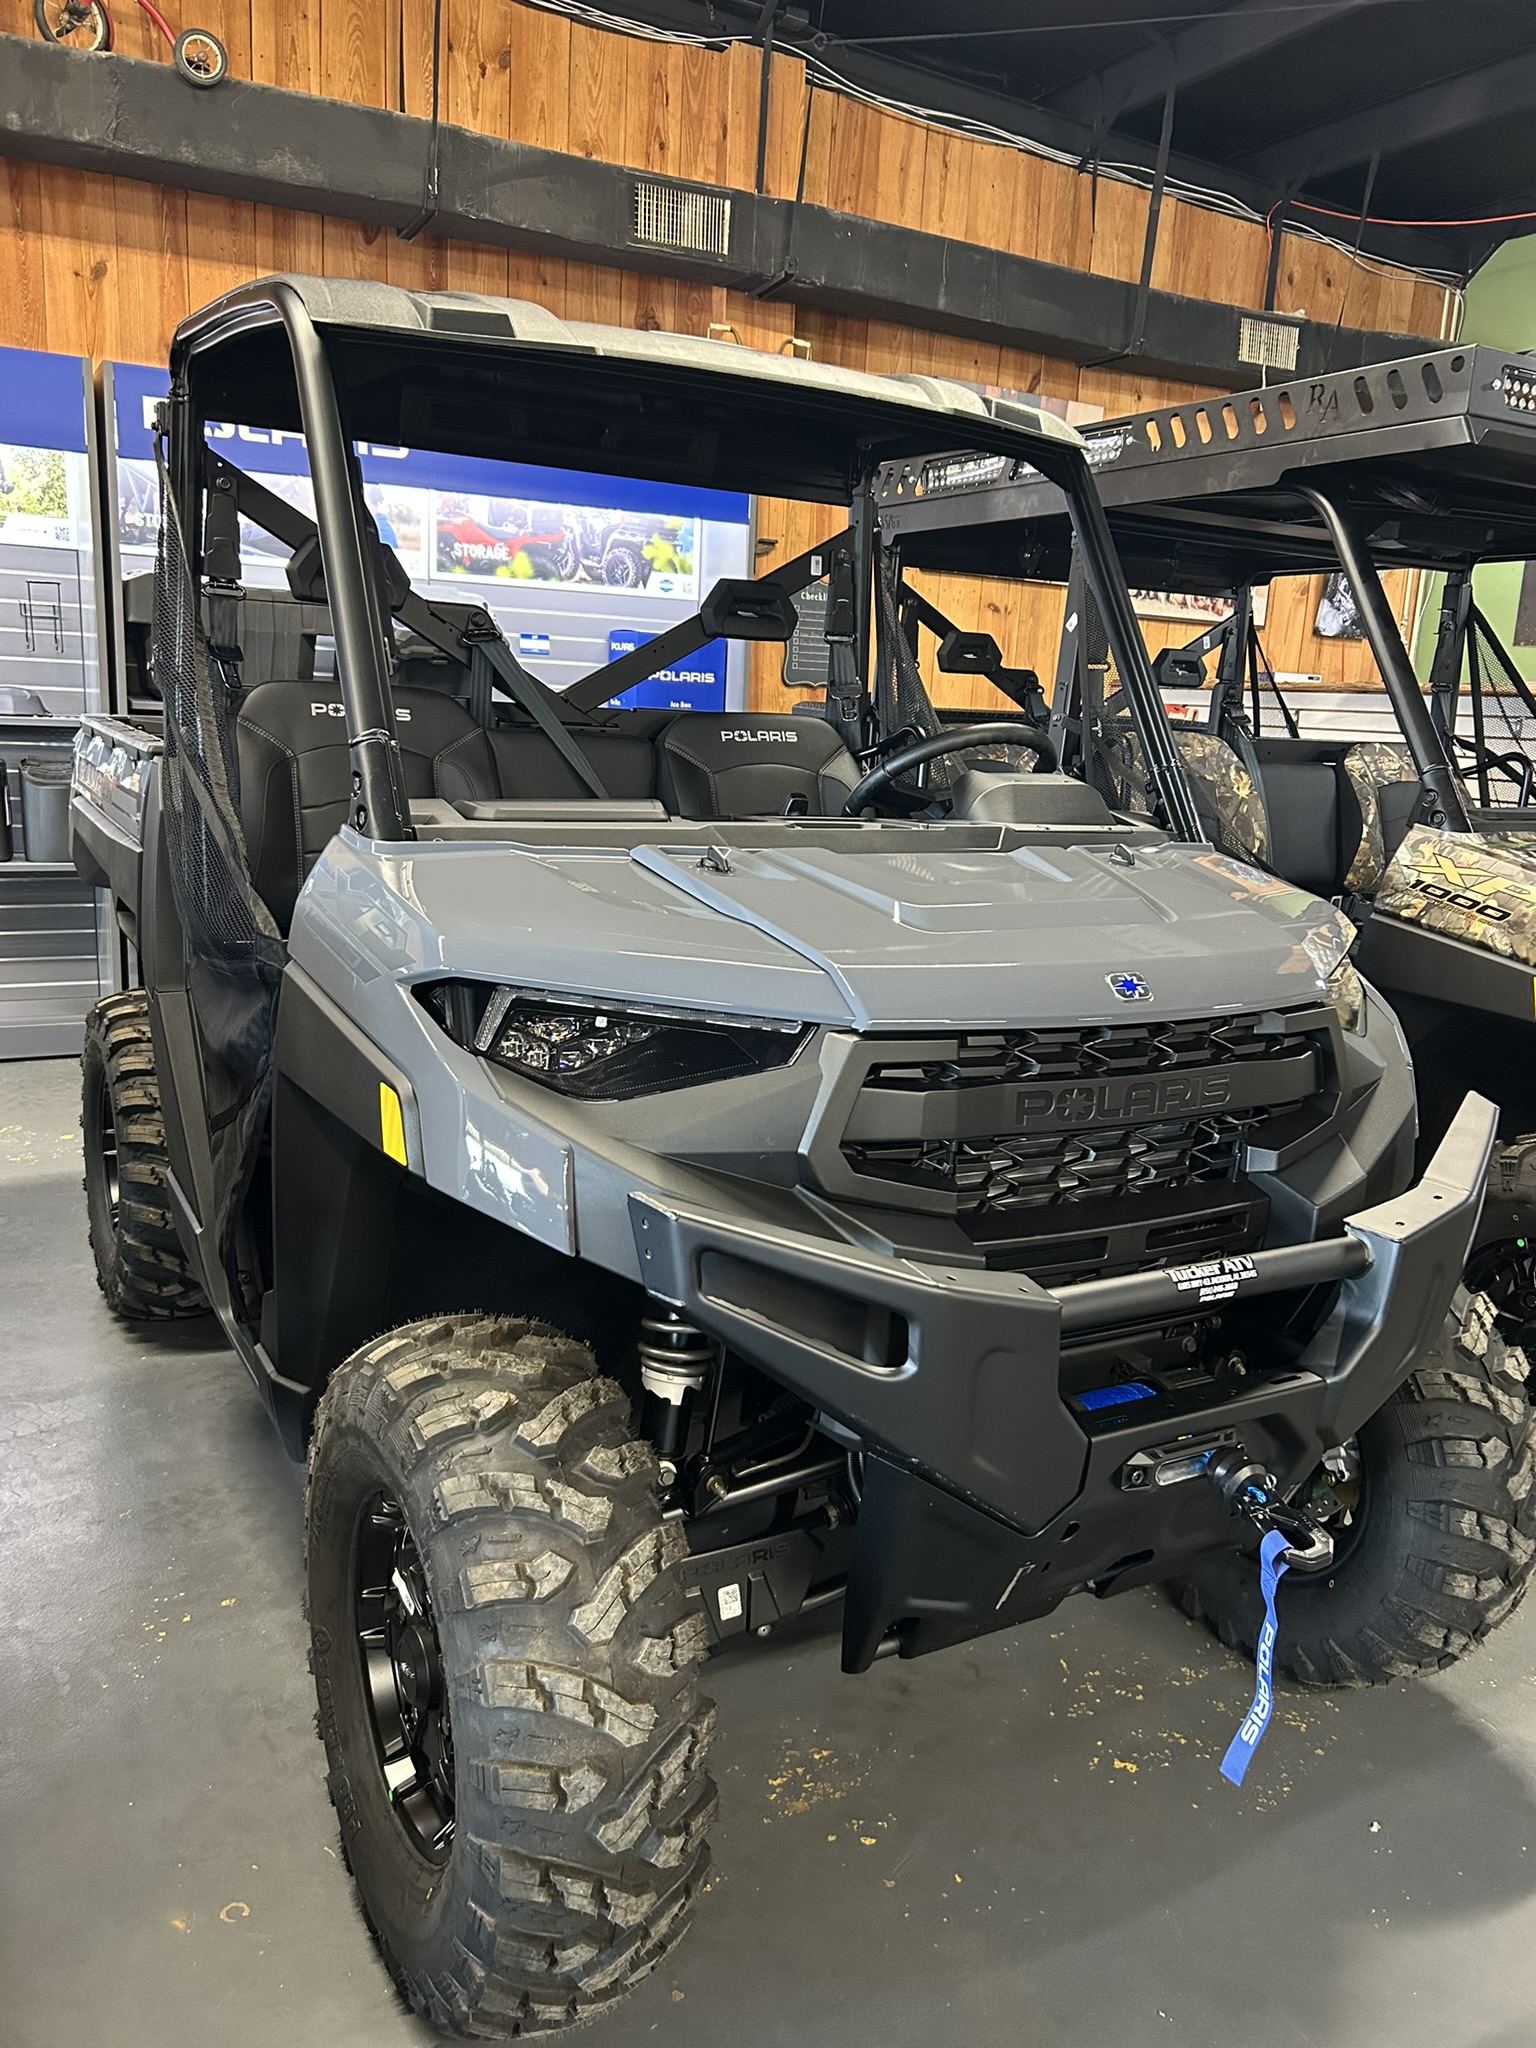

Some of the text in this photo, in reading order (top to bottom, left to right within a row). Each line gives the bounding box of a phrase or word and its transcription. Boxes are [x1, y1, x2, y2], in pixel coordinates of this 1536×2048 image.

[453, 542, 510, 561] STORAGE
[720, 730, 798, 743] POLARIS
[1406, 878, 1514, 922] 1000
[1015, 1073, 1232, 1127] POLARIS
[1164, 1264, 1221, 1283] Tucker
[1222, 1255, 1255, 1273] ATV
[682, 1542, 792, 1581] POLARIS
[1240, 1620, 1275, 1746] POLARIS
